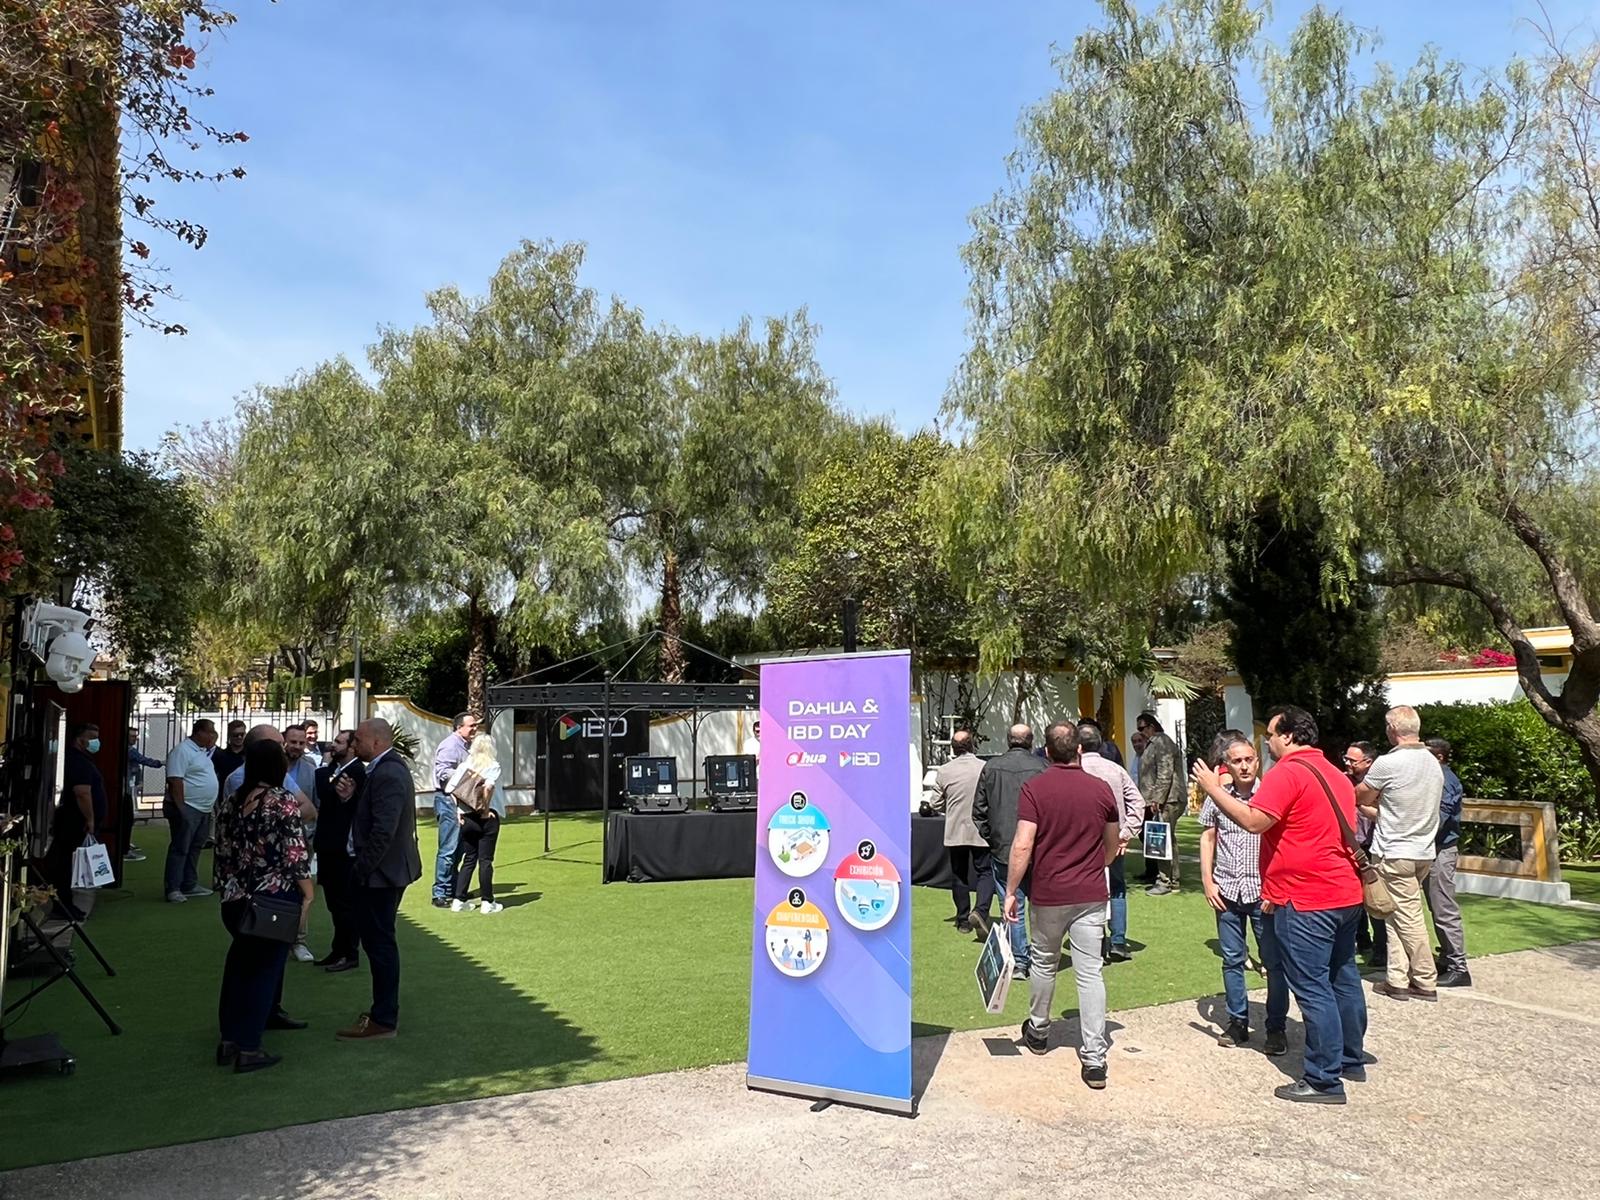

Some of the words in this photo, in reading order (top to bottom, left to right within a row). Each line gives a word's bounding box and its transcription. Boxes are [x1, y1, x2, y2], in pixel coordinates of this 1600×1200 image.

[789, 701, 856, 716] DAHUA
[862, 699, 879, 713] &
[787, 725, 823, 740] IBD
[830, 724, 871, 739] DAY
